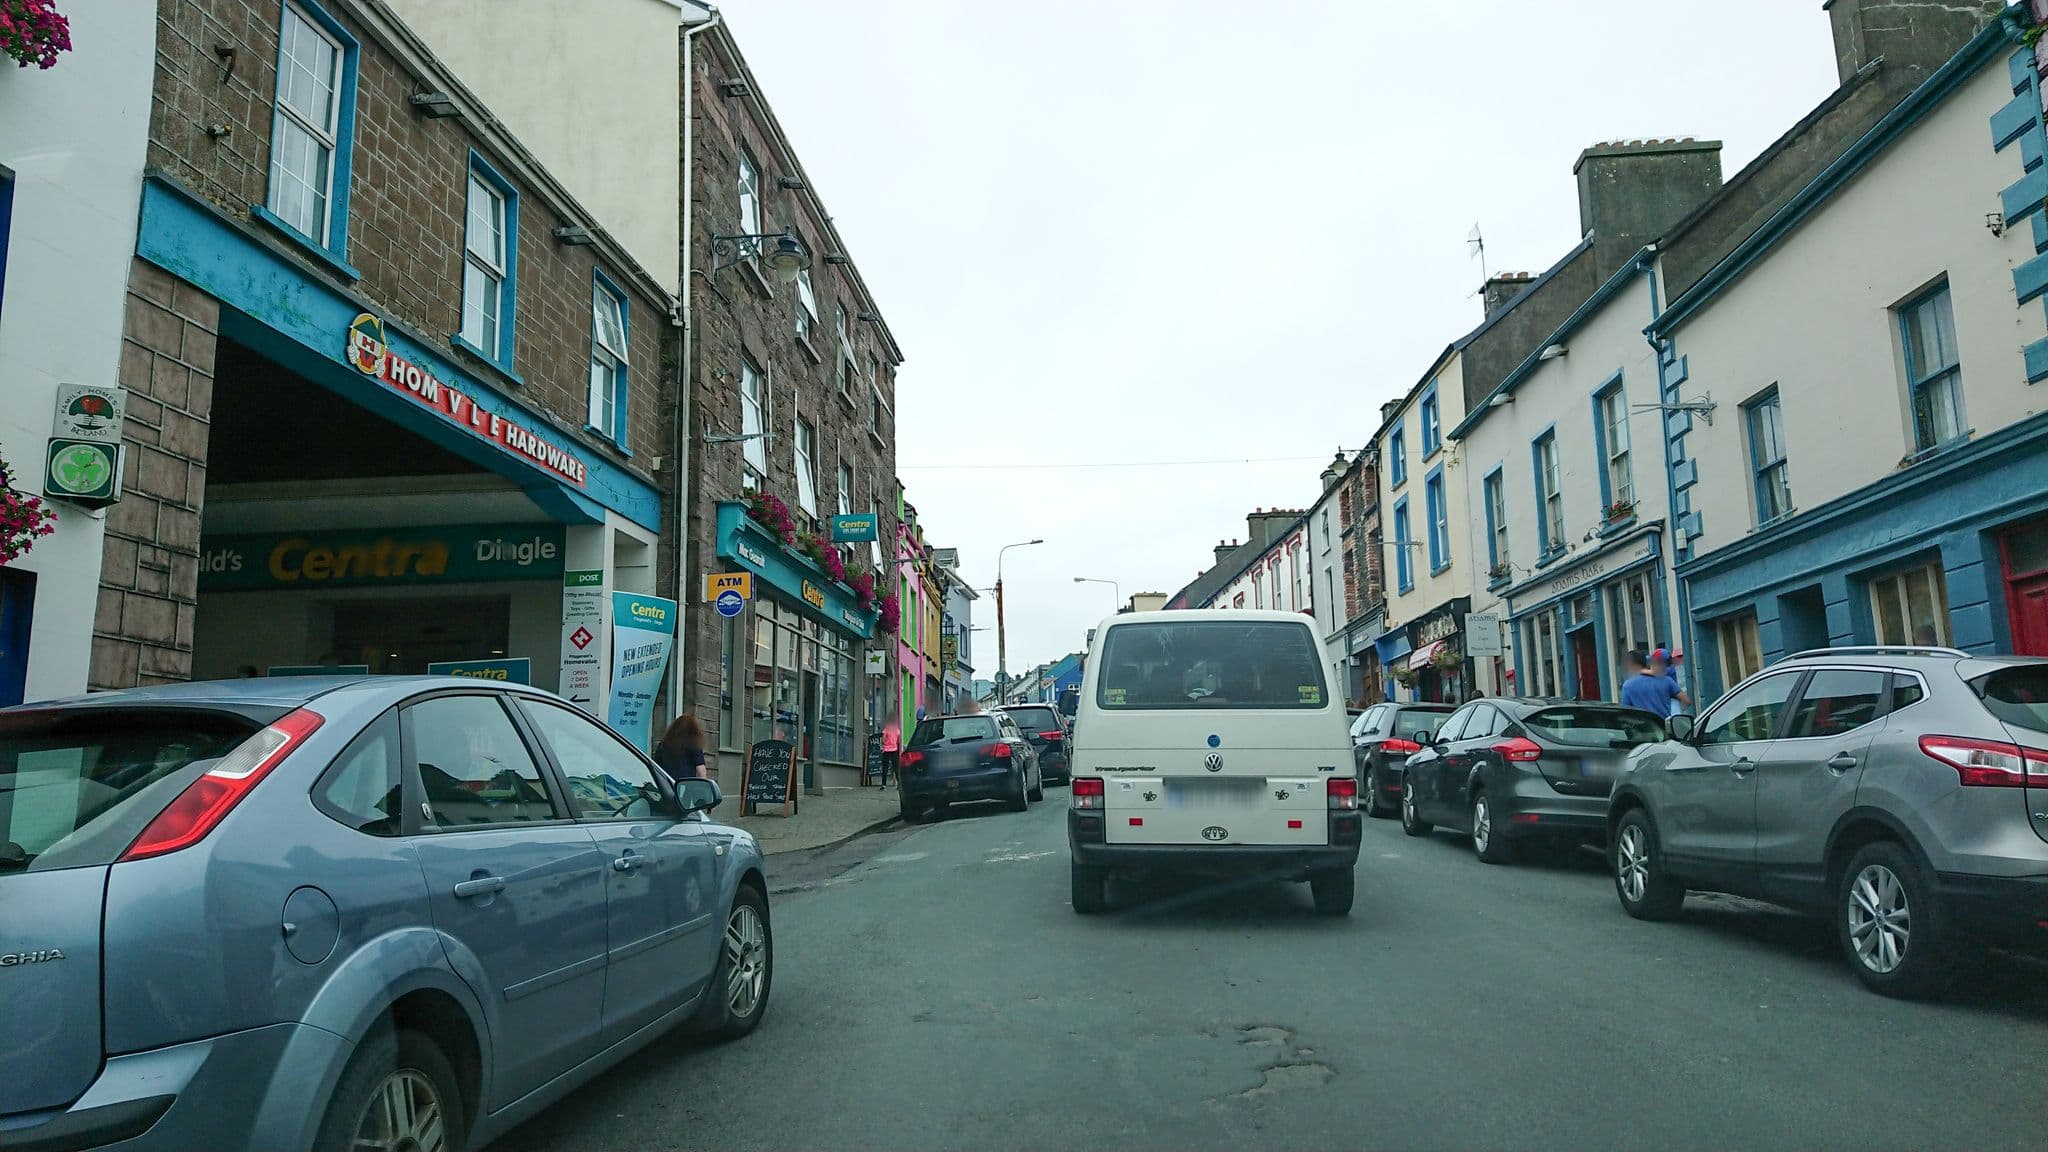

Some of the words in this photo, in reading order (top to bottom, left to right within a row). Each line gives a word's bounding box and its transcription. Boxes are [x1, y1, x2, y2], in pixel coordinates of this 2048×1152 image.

[60, 390, 82, 414] FAMILY
[87, 388, 118, 407] HOMES
[505, 423, 585, 483] HARDWARE
[838, 520, 870, 529] Centra
[268, 535, 449, 582] Centra
[476, 536, 556, 566] Dingle
[579, 574, 600, 583] post
[717, 576, 742, 587] ATM
[1551, 572, 1580, 594] ADAMS
[802, 579, 826, 610] Centra
[630, 602, 666, 620] Centra
[623, 648, 636, 661] NEW
[637, 641, 662, 659] EXTENDED
[621, 660, 646, 678] OPENING
[753, 748, 775, 758] HAVE
[779, 748, 791, 759] YOU
[761, 772, 780, 782] OUR
[0, 949, 65, 967] GHIA
